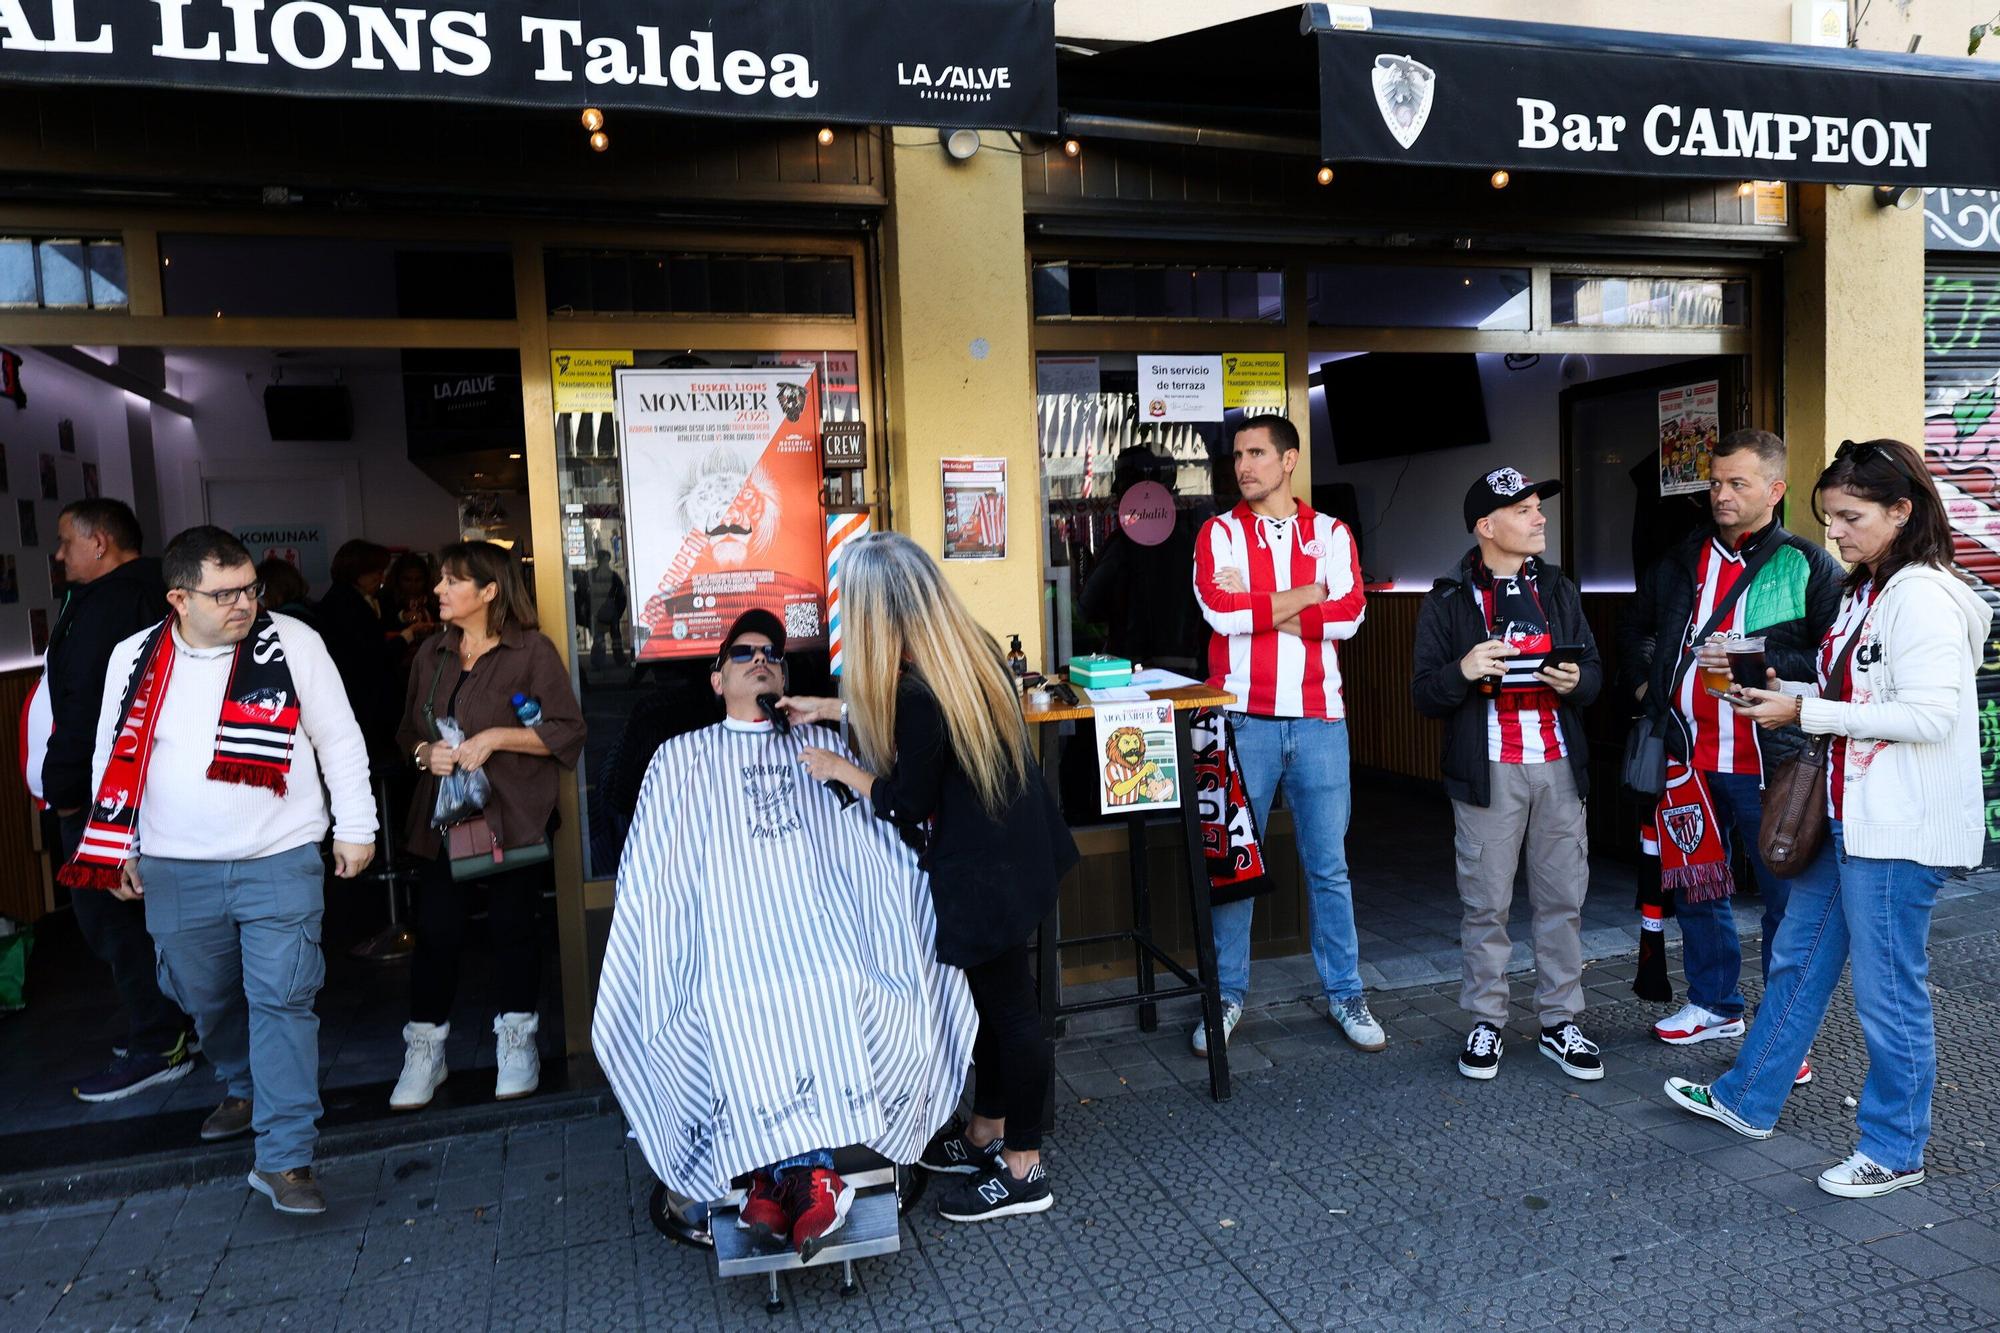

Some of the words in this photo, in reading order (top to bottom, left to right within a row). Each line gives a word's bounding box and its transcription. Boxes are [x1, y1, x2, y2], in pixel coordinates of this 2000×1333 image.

[151, 0, 491, 76] LIONS
[521, 15, 819, 99] Taldea
[898, 62, 932, 86] LA
[935, 65, 1011, 89] SALVE
[1517, 97, 1626, 152] Bar
[1643, 103, 1932, 168] CAMPEON
[1151, 365, 1168, 376] Sin
[1170, 364, 1210, 376] servicio
[433, 382, 452, 400] LA
[453, 375, 496, 397] SALVE
[691, 383, 732, 392] EUSKAL
[736, 383, 767, 392] LIONS
[1157, 381, 1169, 390] de
[1172, 381, 1206, 390] terraza
[639, 393, 768, 412] MOVEMBER
[240, 530, 319, 544] KOMUNAK
[742, 764, 792, 780] BARBER
[1663, 807, 1686, 816] ATHLETIC
[1675, 833, 1700, 854] BILBAO
[978, 1178, 1009, 1205] N
